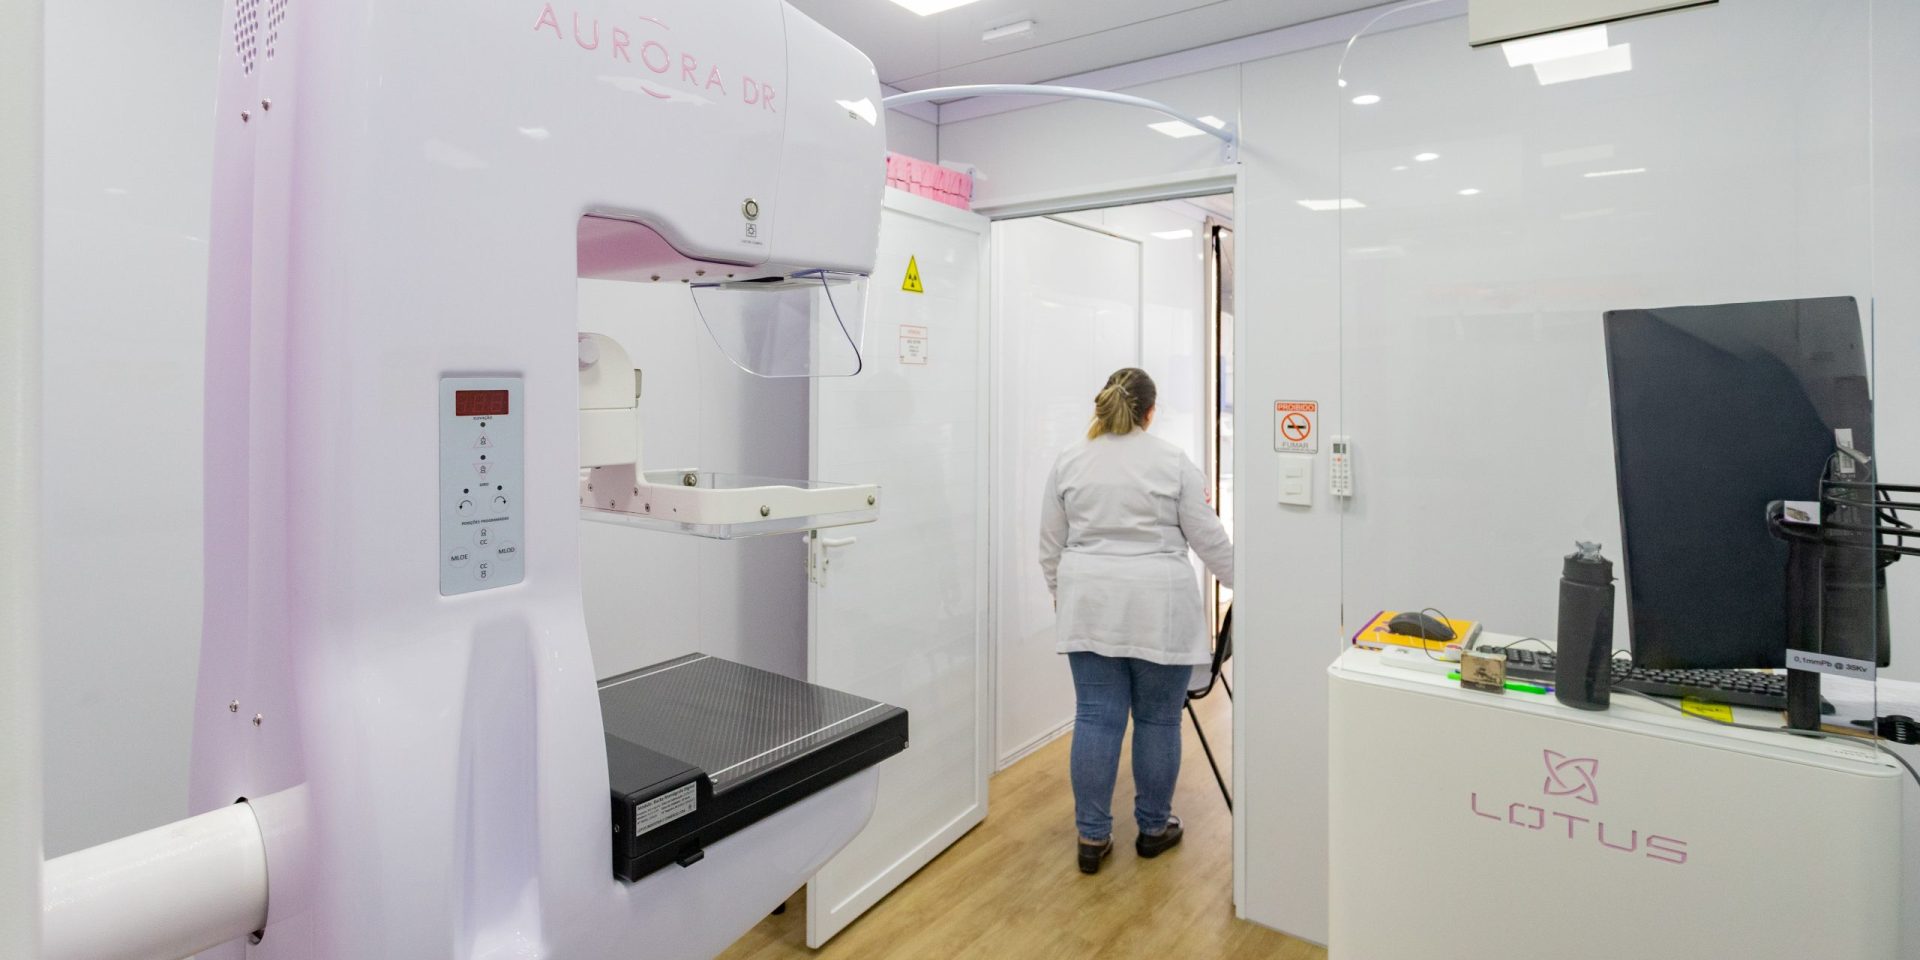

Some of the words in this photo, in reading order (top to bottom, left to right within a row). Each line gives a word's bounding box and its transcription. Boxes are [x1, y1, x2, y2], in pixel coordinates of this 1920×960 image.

[534, 2, 727, 96] AURORA
[742, 75, 777, 113] DR
[1278, 403, 1315, 411] PROIBIDO
[498, 546, 516, 554] MLOD
[450, 553, 469, 561] MLOE
[1470, 792, 1688, 865] LOTUS
